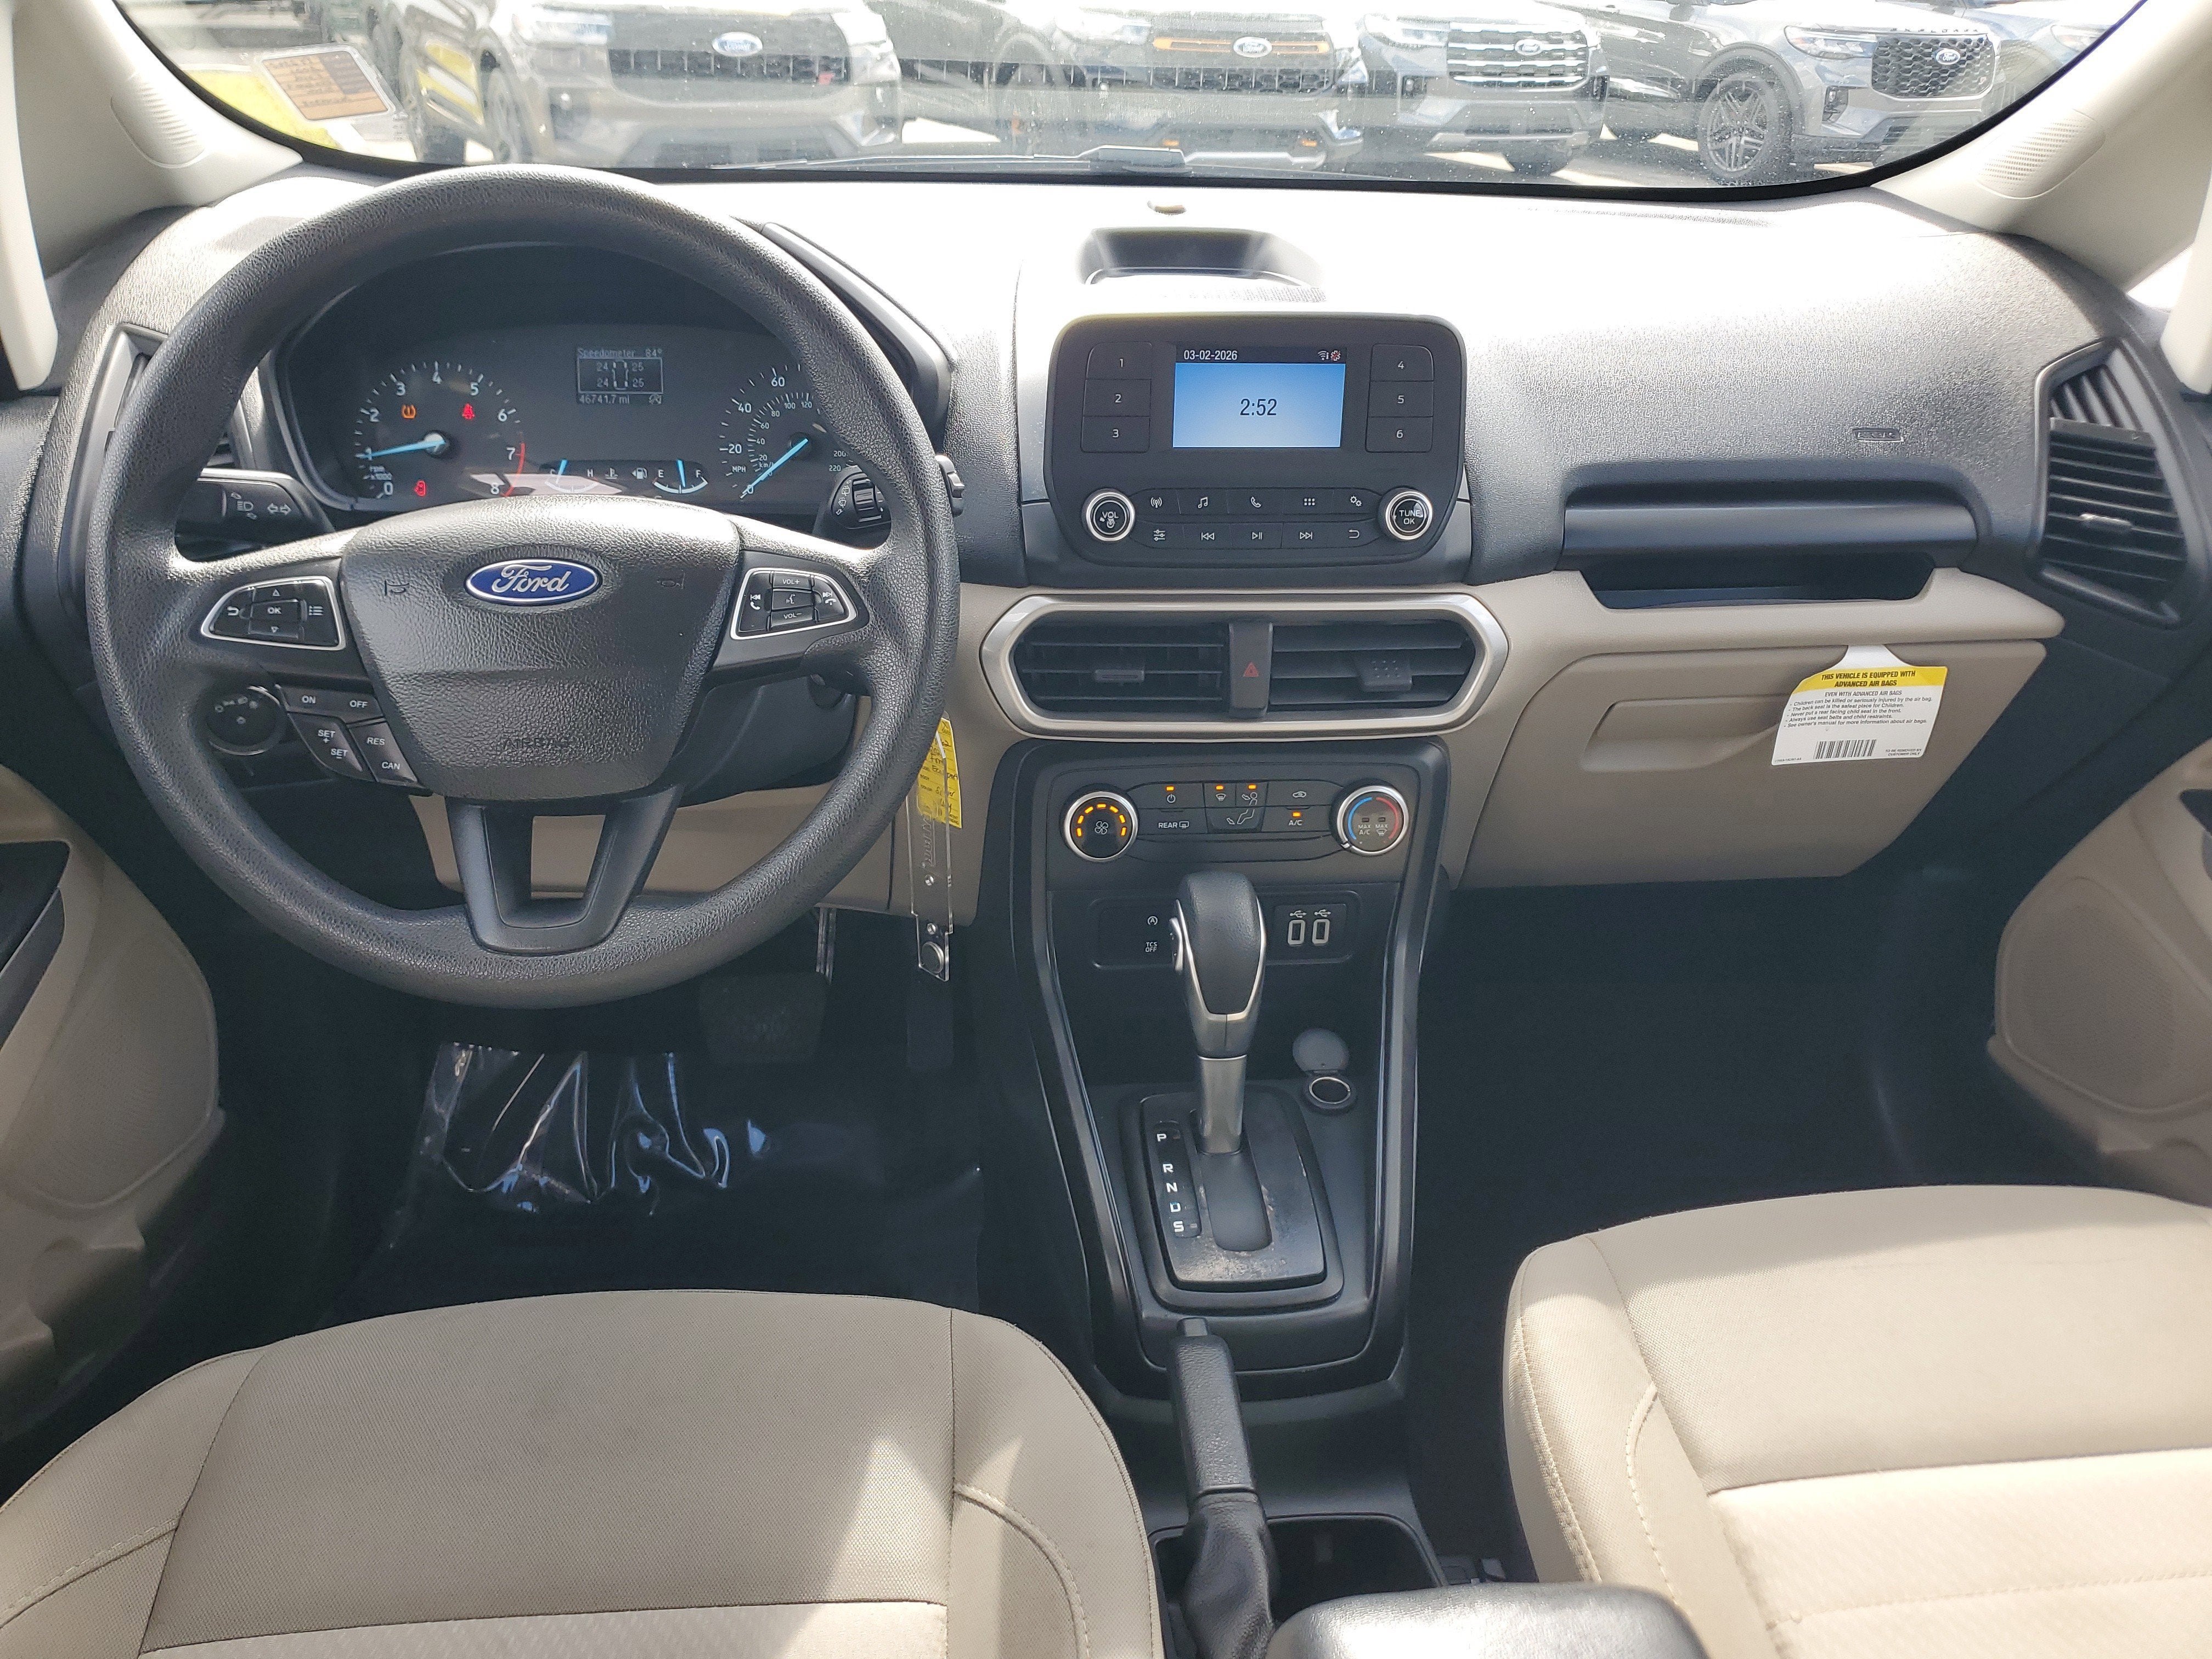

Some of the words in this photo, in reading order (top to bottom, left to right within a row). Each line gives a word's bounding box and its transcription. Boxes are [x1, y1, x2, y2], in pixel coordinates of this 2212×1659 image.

[578, 348, 635, 357] Speedometer
[1183, 350, 1238, 360] 03-02-2026
[1119, 359, 1124, 368] 1
[1397, 360, 1405, 370] 4
[432, 371, 442, 385] 4
[771, 377, 785, 387] 60
[396, 381, 406, 396] 3
[469, 382, 479, 396] 5
[1115, 394, 1122, 403] 2
[1397, 395, 1404, 404] 5
[738, 403, 752, 413] 40
[1240, 398, 1277, 416] 2:52
[370, 407, 380, 422] 2
[498, 408, 507, 422] 6
[1112, 429, 1119, 438] 3
[1396, 430, 1403, 439] 6
[506, 447, 516, 460] 7
[729, 443, 742, 454] 20
[587, 469, 594, 477] H
[658, 470, 664, 478] E
[696, 470, 702, 478] F
[383, 481, 393, 495] 0
[492, 565, 571, 592] Ford
[267, 606, 281, 614] OK
[302, 695, 316, 704] ON
[349, 699, 368, 708] OFF
[318, 730, 335, 738] SET
[367, 737, 385, 746] RES
[331, 748, 348, 756] SET
[381, 761, 400, 770] CAN
[1157, 1133, 1167, 1142] P
[1163, 1163, 1173, 1173] R
[1166, 1182, 1177, 1193] N
[1170, 1201, 1181, 1212] D
[1173, 1221, 1184, 1232] S
